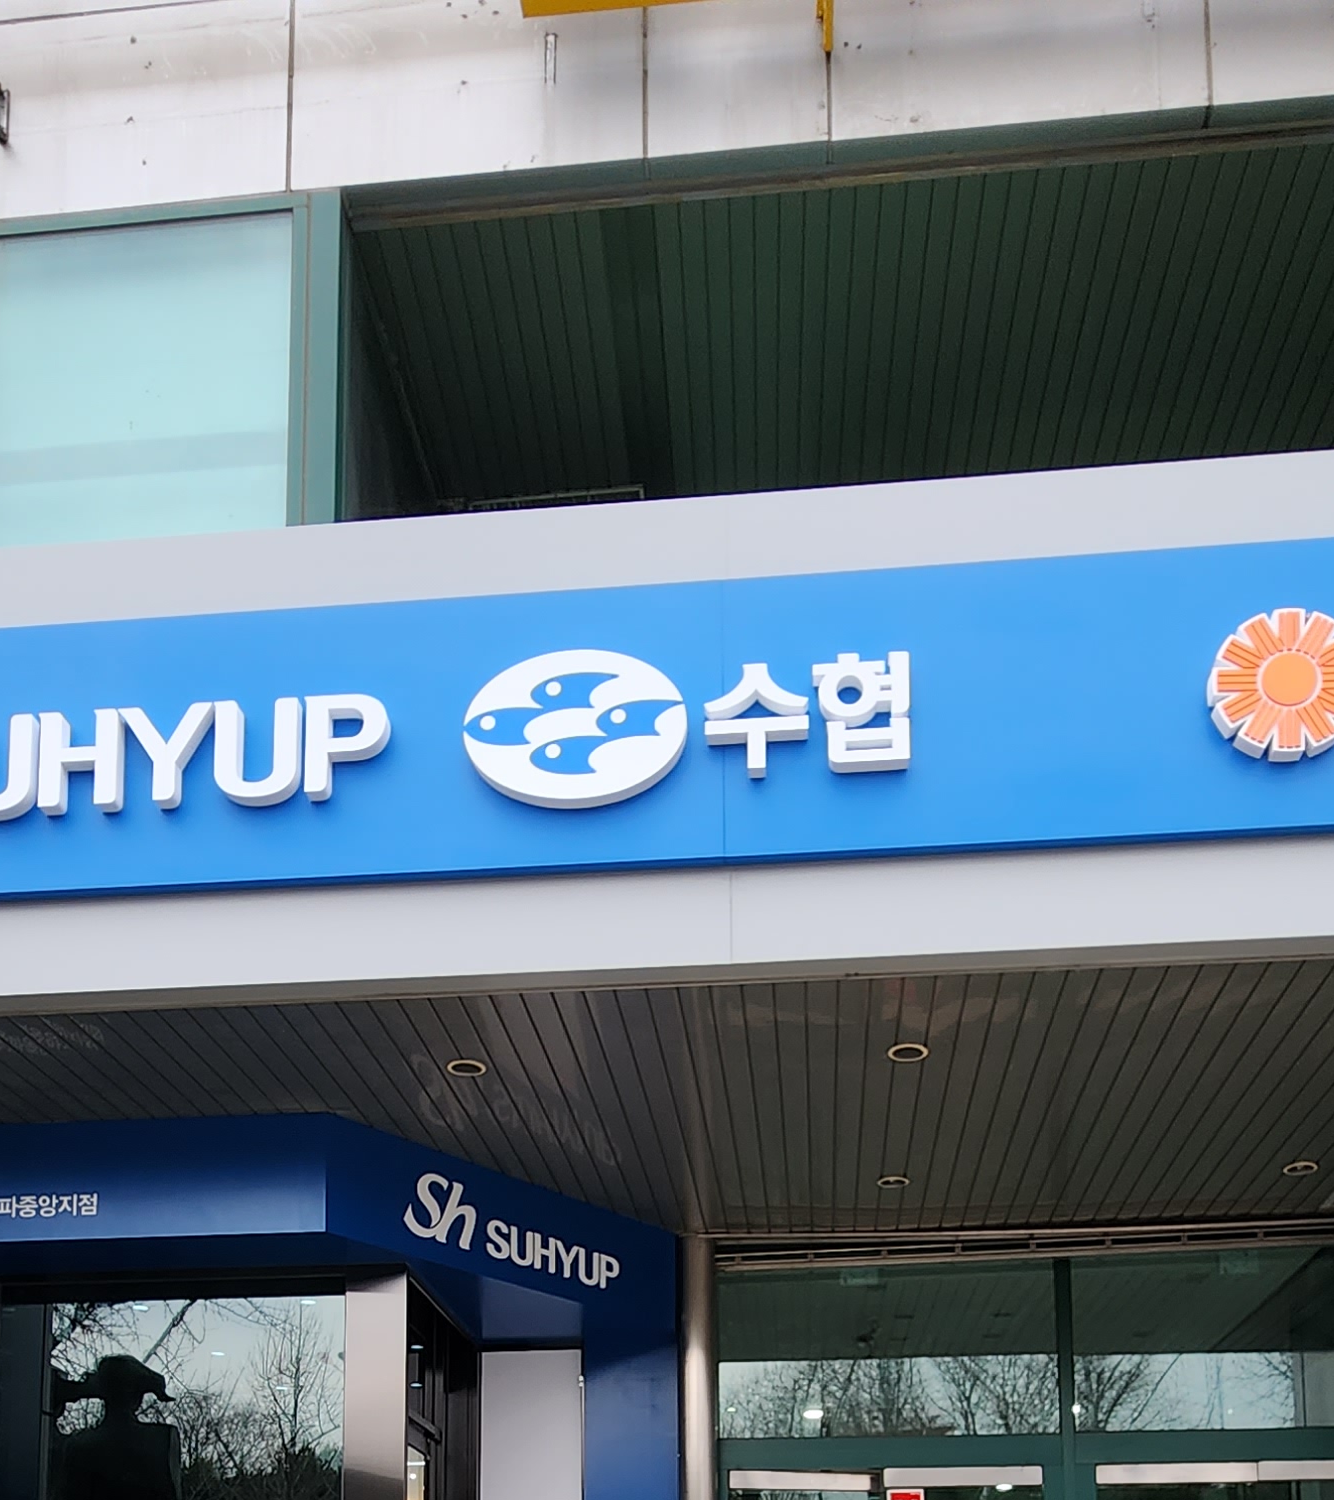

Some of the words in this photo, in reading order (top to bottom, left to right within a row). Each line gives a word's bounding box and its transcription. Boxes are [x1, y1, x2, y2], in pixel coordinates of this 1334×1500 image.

[703, 648, 914, 779] 수협
[403, 1172, 477, 1250] Sh
[486, 1219, 620, 1289] SUHYUP
